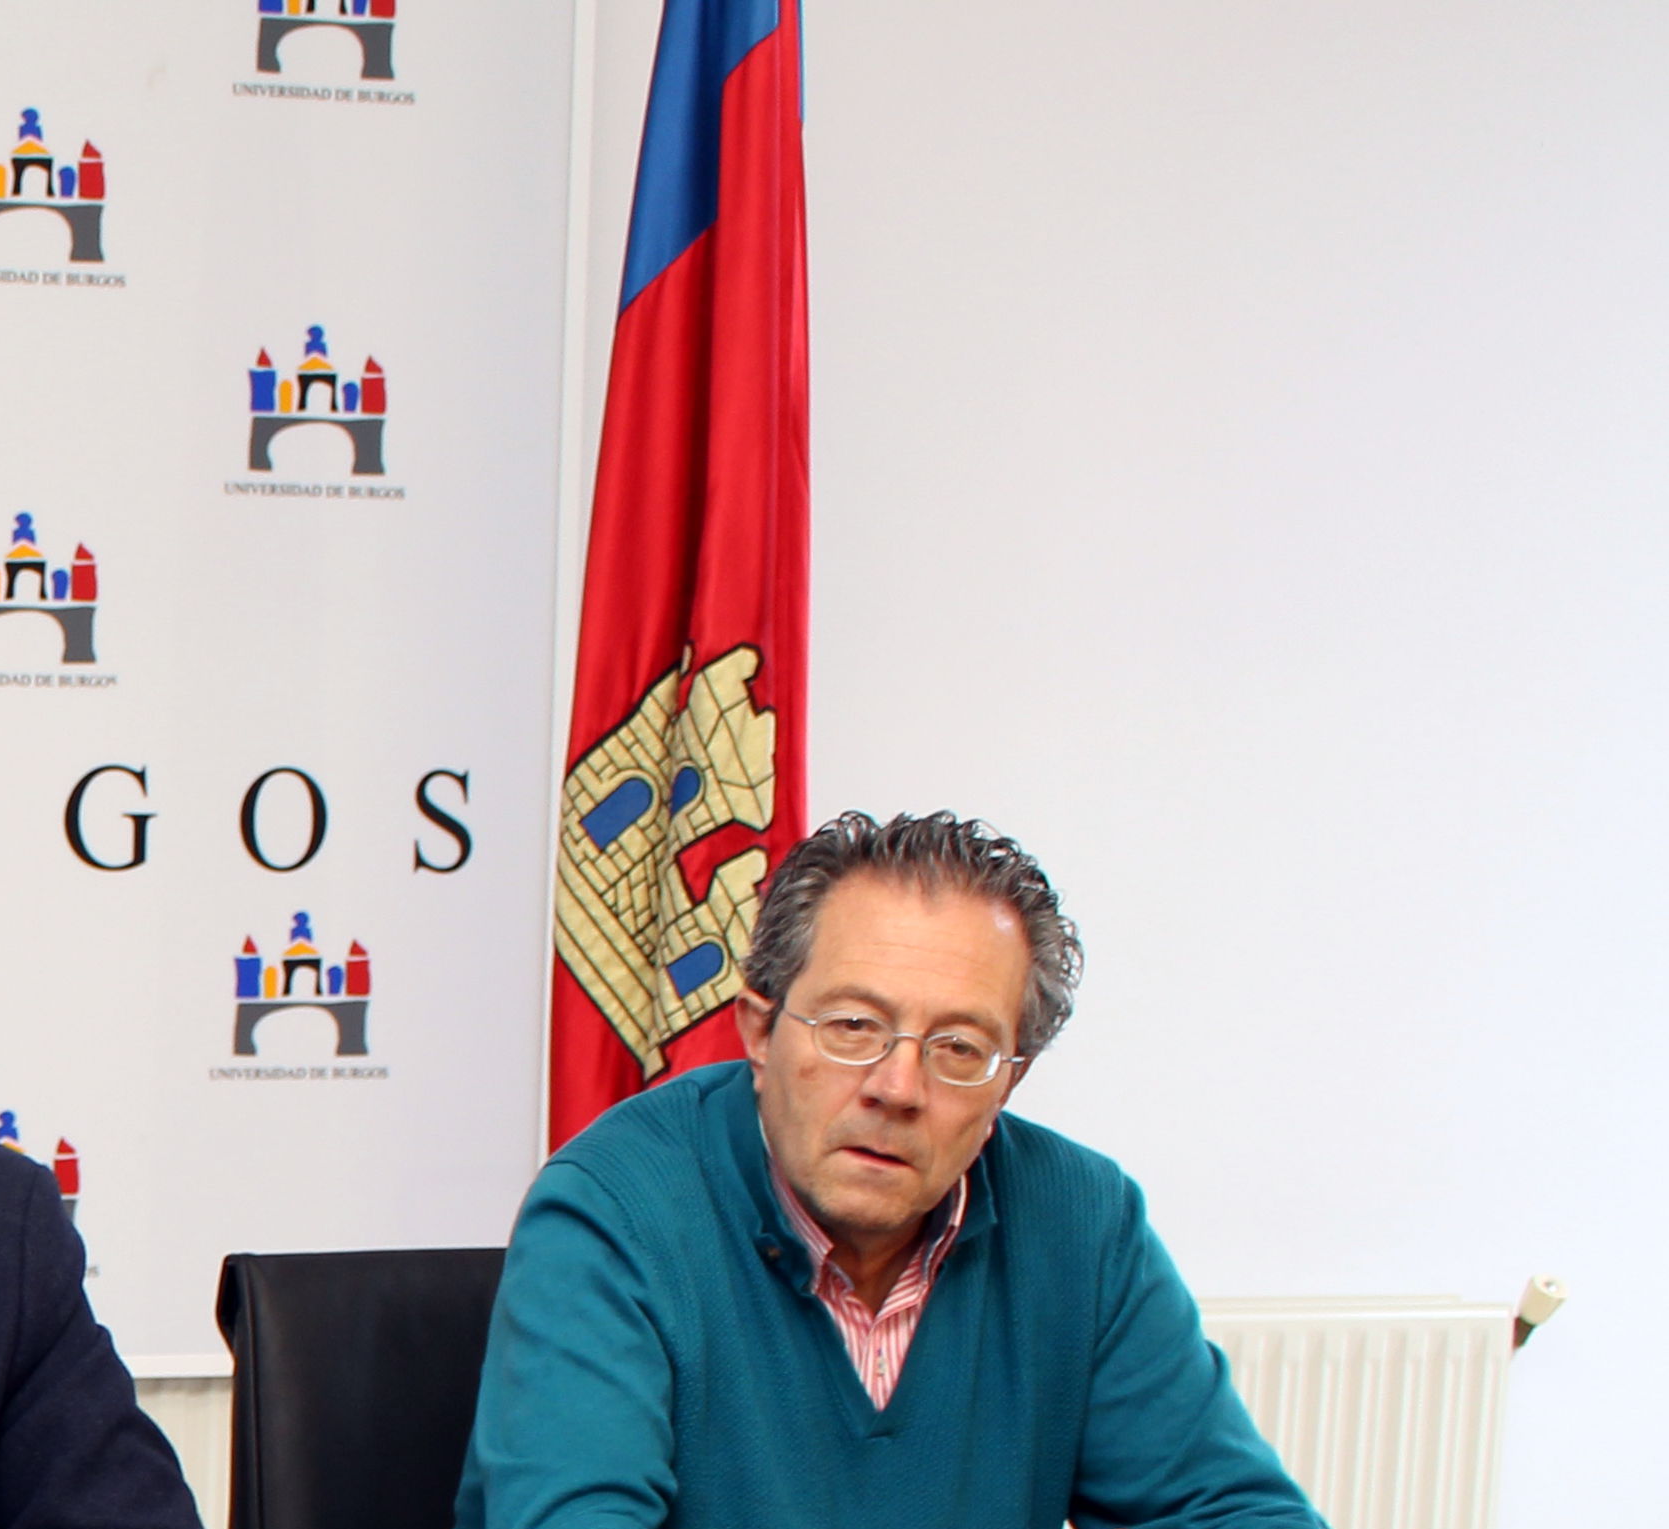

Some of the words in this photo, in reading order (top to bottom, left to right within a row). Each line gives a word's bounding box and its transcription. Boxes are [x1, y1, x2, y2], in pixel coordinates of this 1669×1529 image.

[232, 85, 333, 99] UNIVERSIDAD
[334, 88, 353, 102] DE
[357, 91, 416, 104] BURGOS
[41, 272, 62, 285] DE
[65, 274, 127, 287] BURGOS
